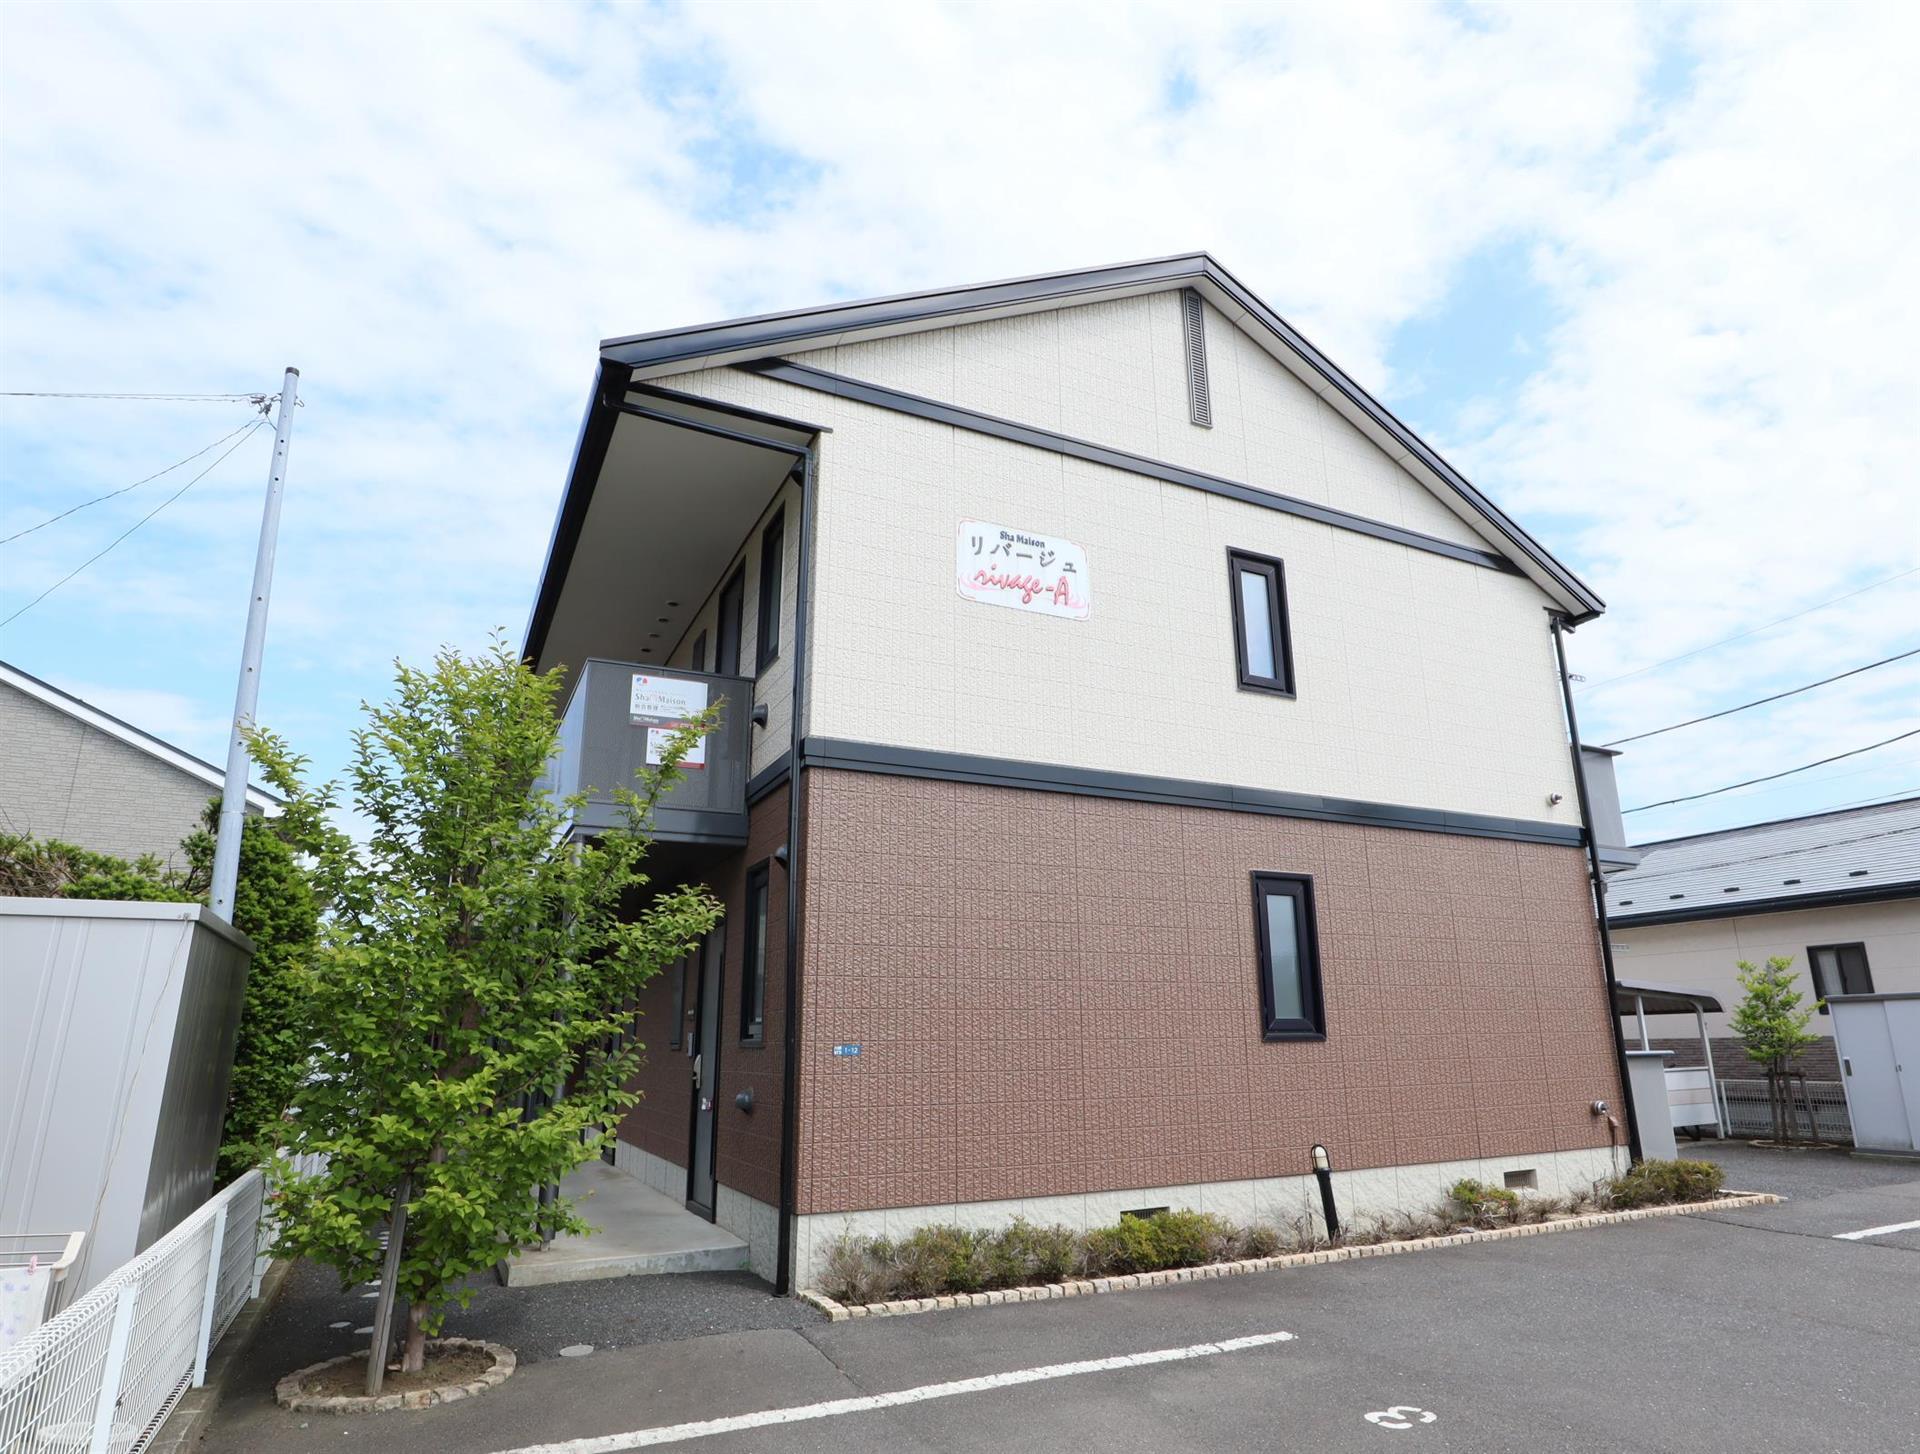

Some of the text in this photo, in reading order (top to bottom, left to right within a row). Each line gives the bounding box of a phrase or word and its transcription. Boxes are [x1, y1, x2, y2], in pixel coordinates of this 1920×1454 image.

[971, 536, 1077, 574] リバージュ
[1000, 530, 1045, 548] Sha Maison
[974, 563, 1070, 606] rivage-A
